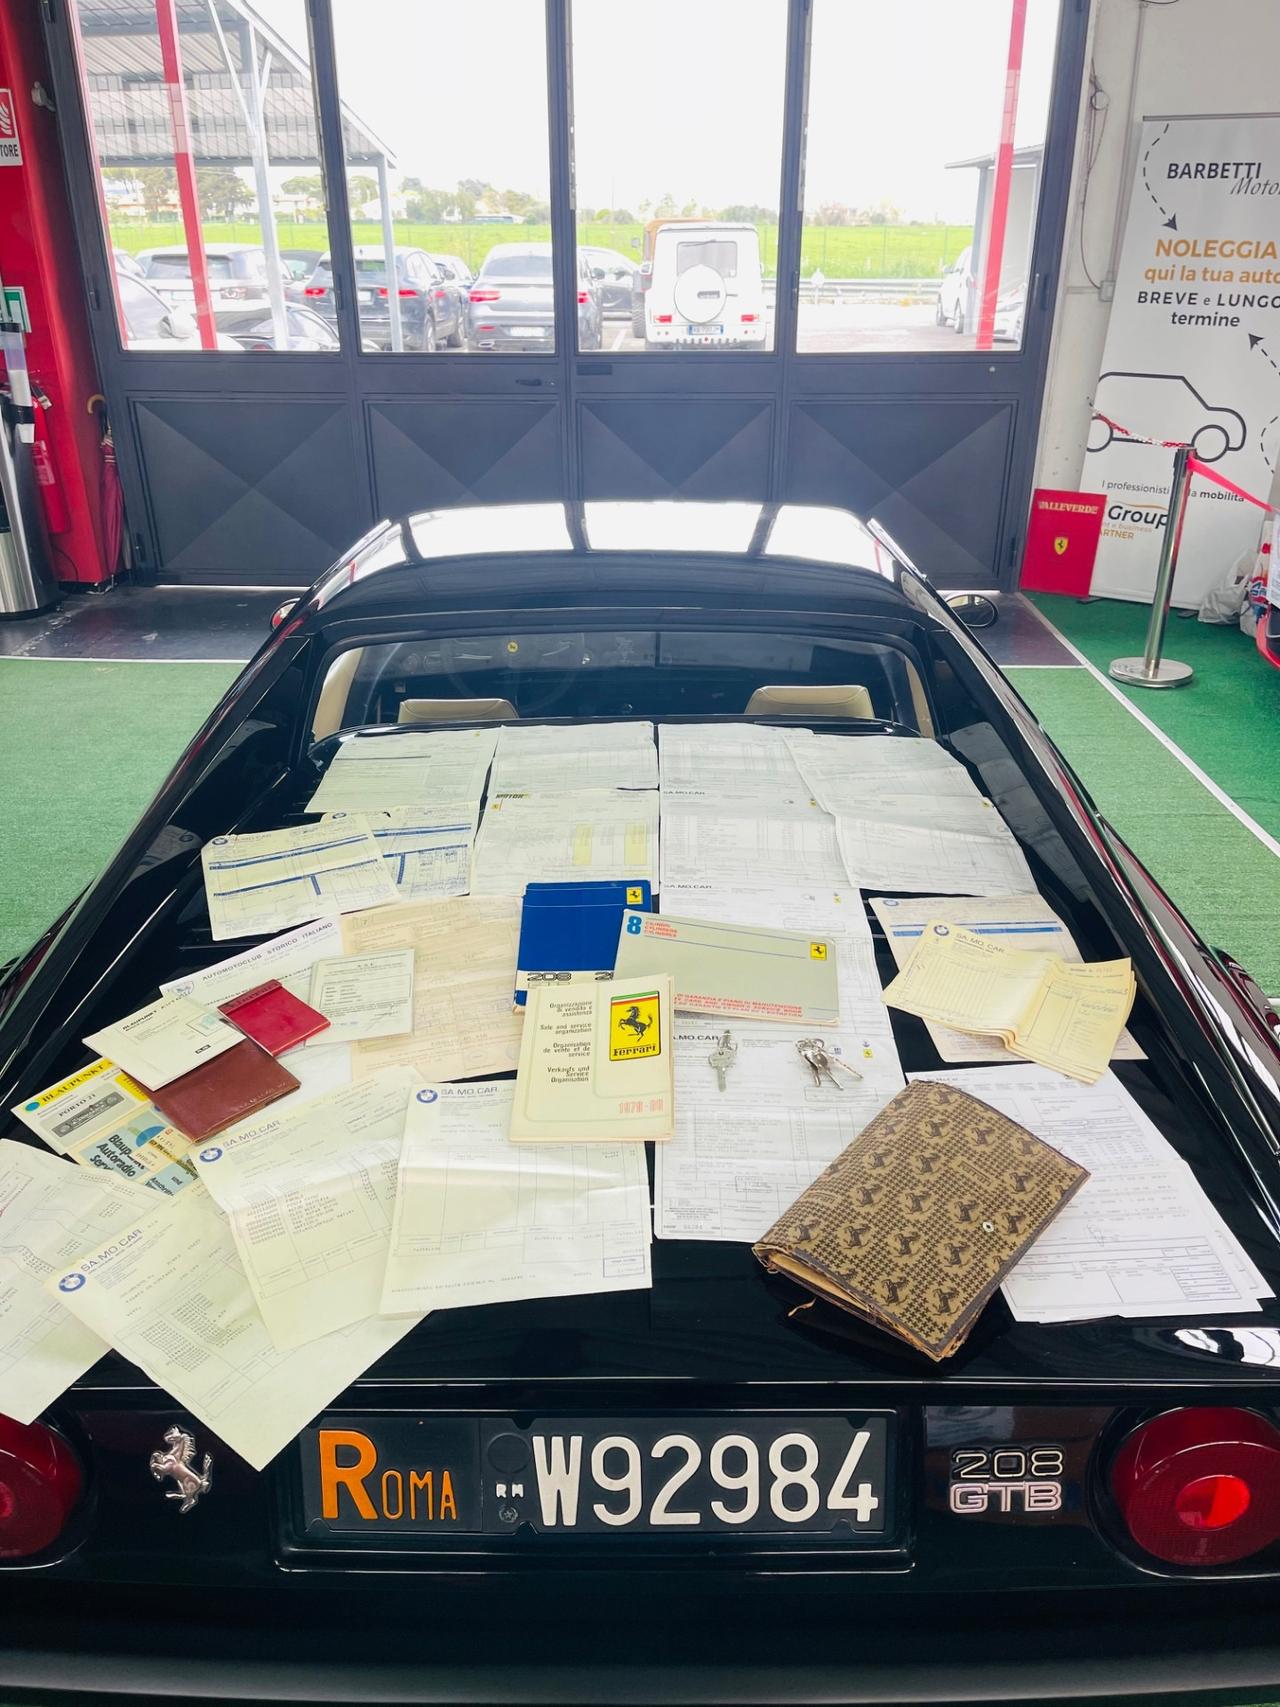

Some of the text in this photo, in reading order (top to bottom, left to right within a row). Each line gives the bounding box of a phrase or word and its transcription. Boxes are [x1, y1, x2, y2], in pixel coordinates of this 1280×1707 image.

[1167, 163, 1262, 179] BARBETTI
[1155, 239, 1278, 259] NOLEGGIA
[1144, 265, 1280, 284] qui la tua auto
[1138, 291, 1280, 309] BREVE e LUNGO
[1171, 312, 1240, 327] termine
[1107, 480, 1170, 495] professionisti
[1108, 505, 1169, 529] Group
[626, 915, 642, 935] 8
[266, 938, 299, 956] STORICO
[302, 922, 333, 939] ITALIANO
[527, 972, 572, 982] 208
[613, 1044, 656, 1057] Ferrari
[42, 1065, 104, 1103] BLAUPUNKT
[96, 1143, 136, 1178] Autoradio
[108, 1134, 145, 1170] Blaup
[952, 1446, 1065, 1480] 208
[532, 1431, 879, 1527] W92984
[949, 1482, 1063, 1514] GTB
